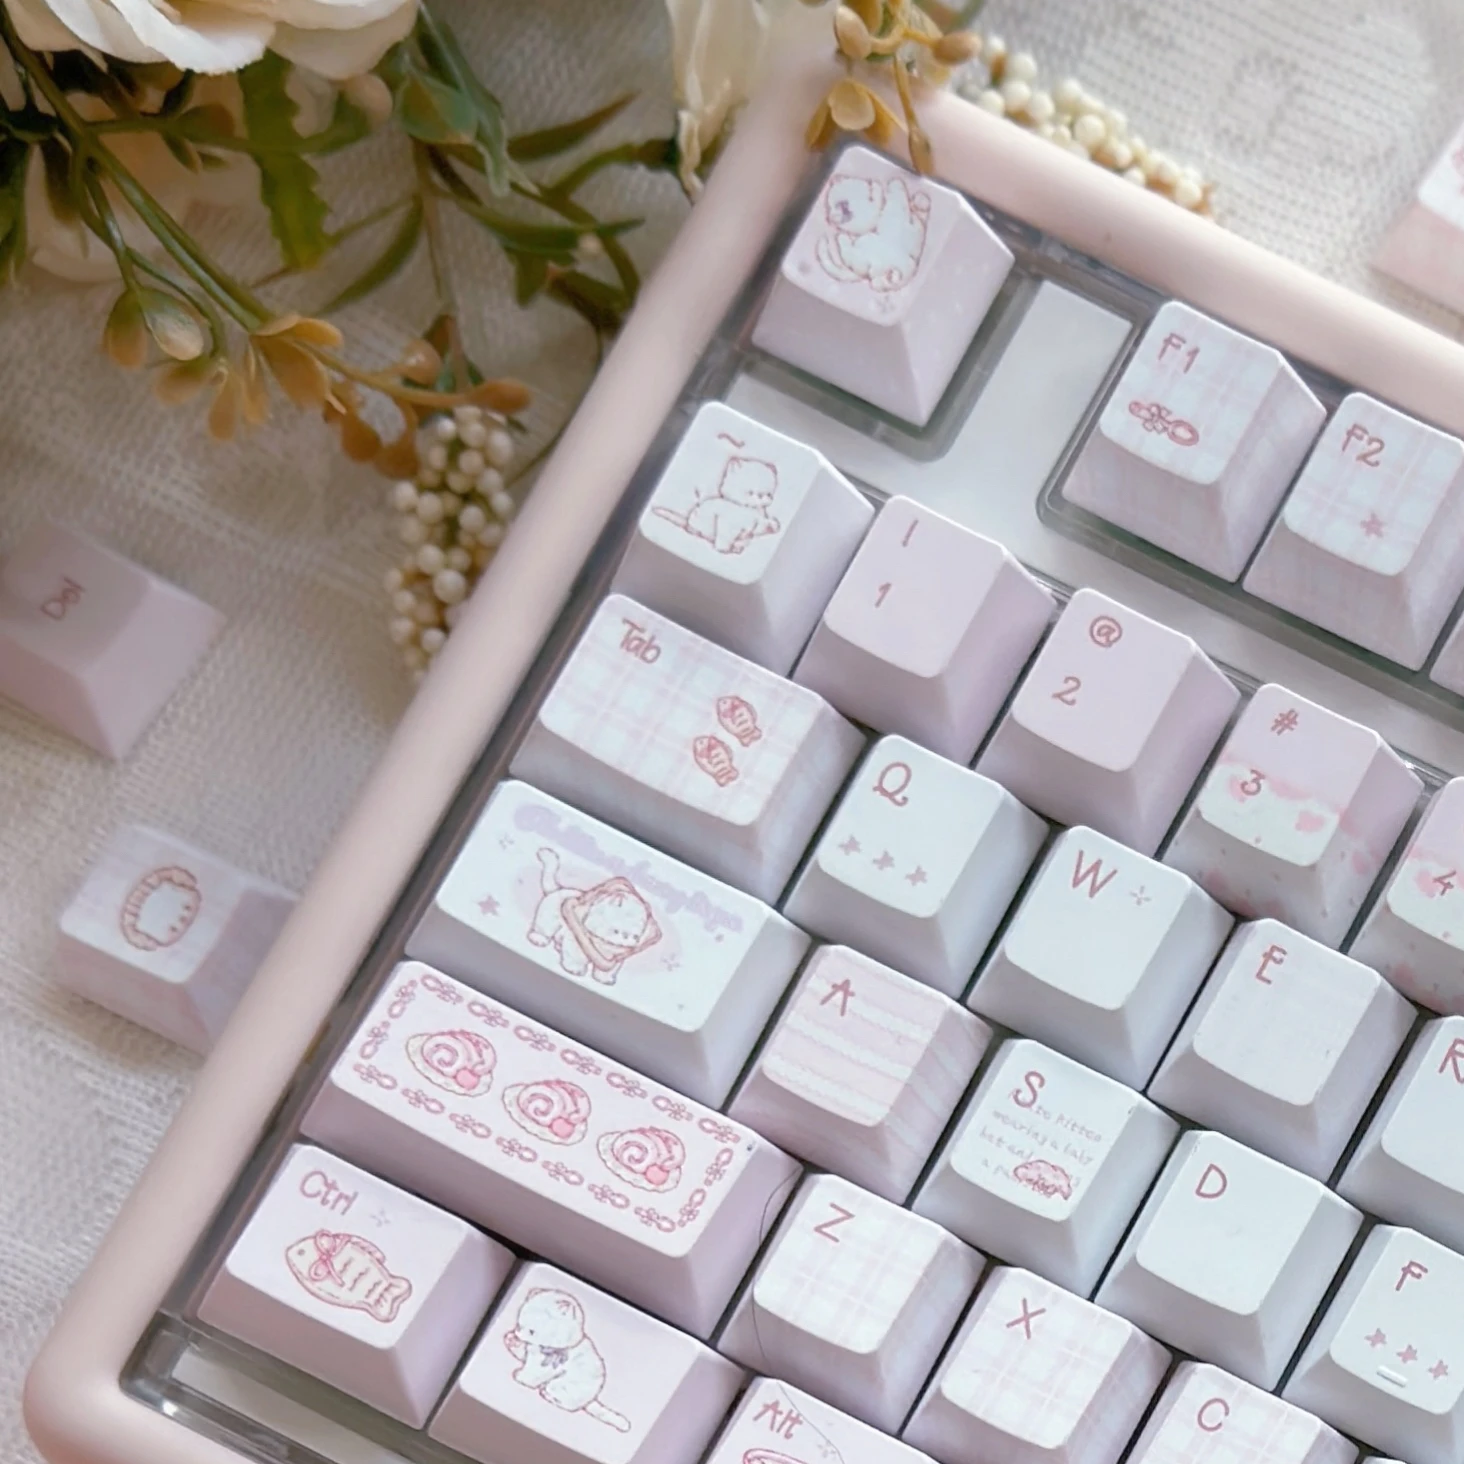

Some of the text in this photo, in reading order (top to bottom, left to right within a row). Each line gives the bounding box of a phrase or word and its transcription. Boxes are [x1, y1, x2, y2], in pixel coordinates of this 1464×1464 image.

[1157, 333, 1200, 374] F1
[1341, 423, 1385, 468] F2
[874, 581, 892, 607] 1
[619, 618, 660, 664] Tab
[1089, 614, 1123, 647] @
[1052, 675, 1081, 705] 2
[1271, 708, 1298, 735] #
[872, 761, 912, 807] Q
[1240, 769, 1265, 796] 3
[1071, 849, 1117, 898] W
[1432, 870, 1457, 896] 4
[1255, 944, 1288, 985] E
[818, 979, 855, 1016] A
[1012, 1071, 1045, 1108] S
[298, 1170, 358, 1216] Ctrl
[1195, 1163, 1228, 1200] D
[813, 1202, 855, 1243] Z
[1395, 1261, 1428, 1292] F
[1006, 1298, 1046, 1339] X
[752, 1398, 803, 1441] Alt
[1197, 1398, 1230, 1432] C
